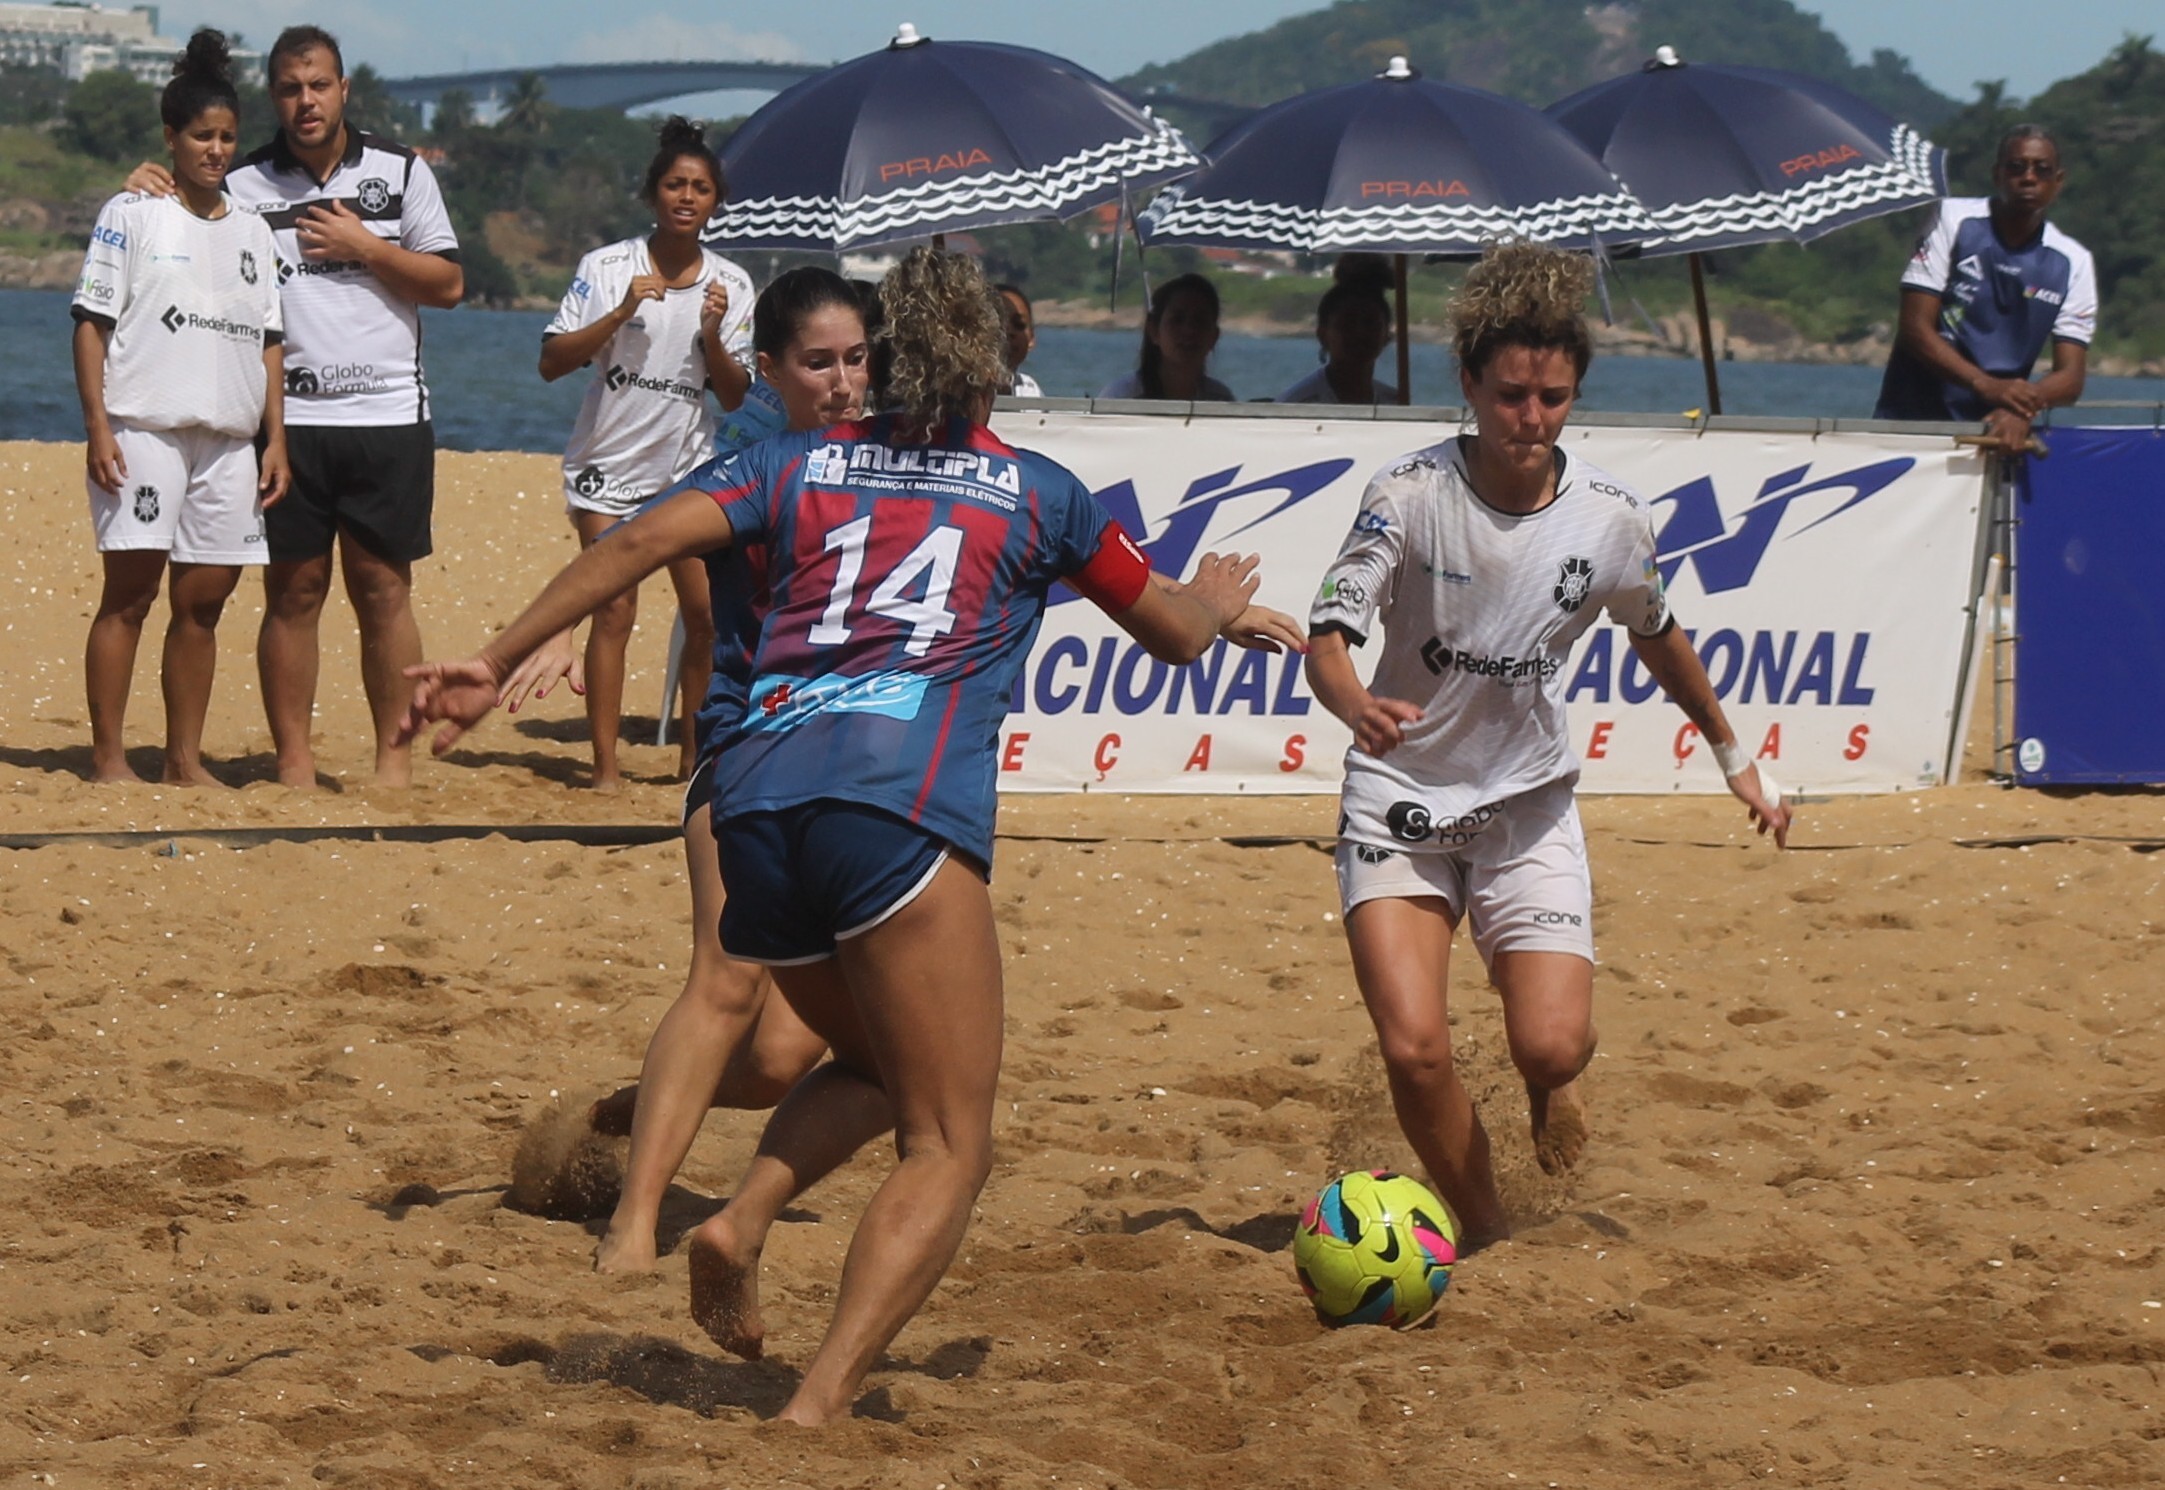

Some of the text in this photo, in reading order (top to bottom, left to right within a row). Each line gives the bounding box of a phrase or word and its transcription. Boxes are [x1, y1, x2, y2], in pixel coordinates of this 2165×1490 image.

[880, 148, 992, 182] PRAIA
[1779, 144, 1862, 177] PRAIA
[1361, 180, 1470, 198] PRAIA
[92, 226, 127, 251] ACEL
[570, 277, 591, 299] CEL
[321, 362, 373, 381] Globo
[847, 477, 1016, 512] SEGURANÇA E MATERIAIS ELÉTRICOS
[807, 515, 963, 657] 14
[1009, 636, 1312, 715] CIONAL
[1565, 628, 1875, 705] ACONAL
